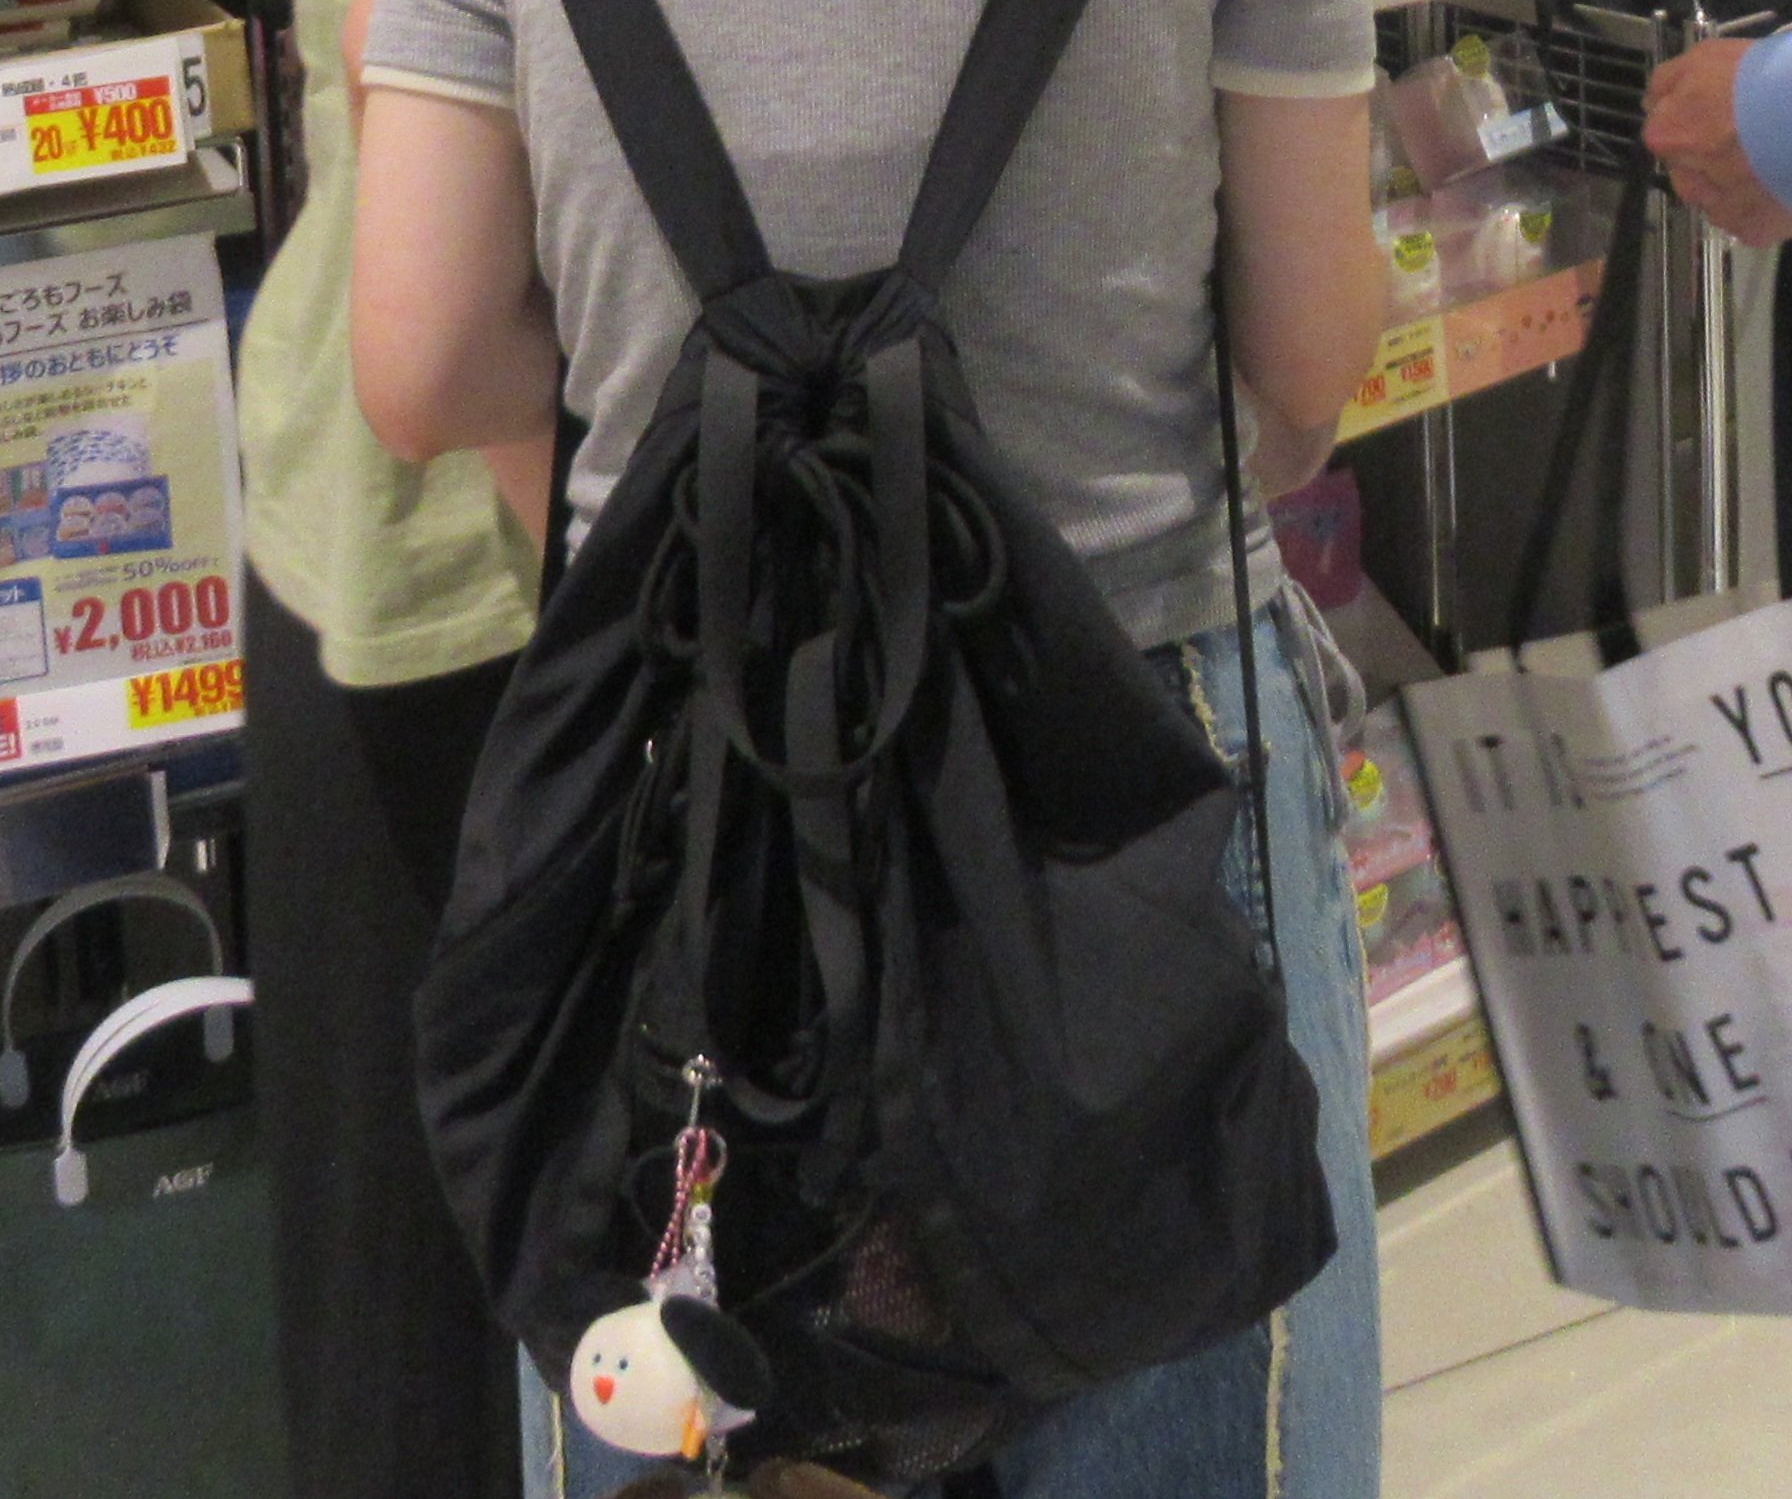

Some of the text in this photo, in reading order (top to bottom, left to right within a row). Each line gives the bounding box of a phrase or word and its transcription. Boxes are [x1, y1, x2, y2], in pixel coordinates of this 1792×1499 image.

[30, 125, 65, 163] 20
[76, 99, 174, 152] ¥400
[54, 575, 230, 655] ¥2,000
